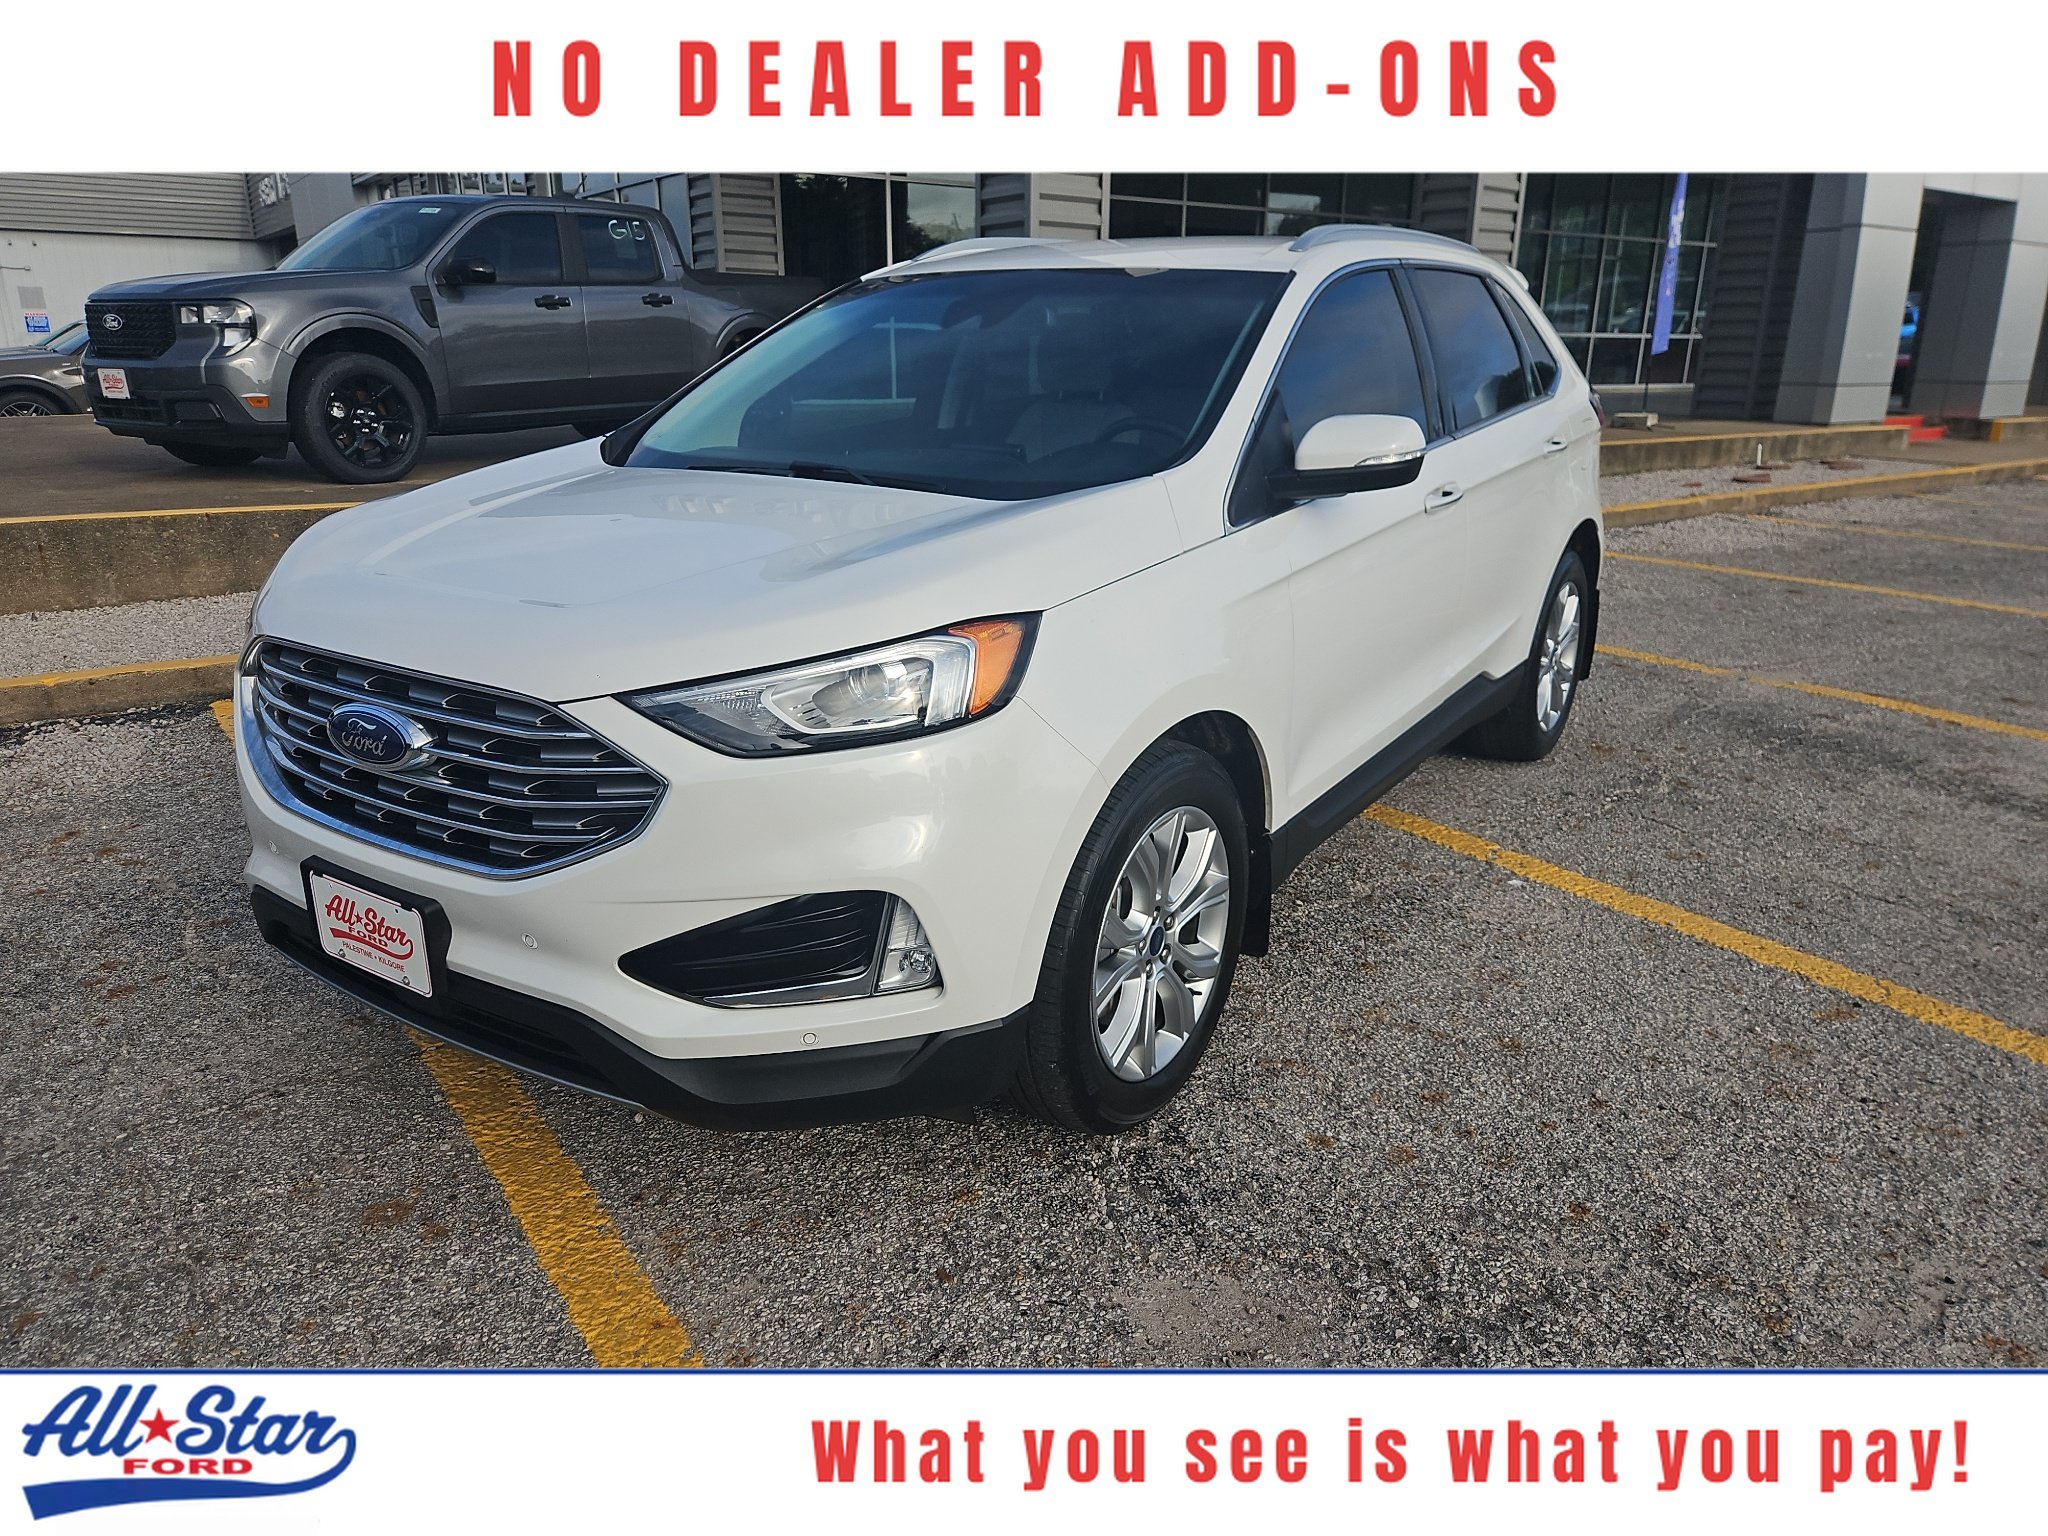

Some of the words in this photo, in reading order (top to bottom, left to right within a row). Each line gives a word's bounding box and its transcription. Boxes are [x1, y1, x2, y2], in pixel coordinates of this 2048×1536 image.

[341, 717, 387, 757] Ford
[325, 894, 356, 926] All
[363, 907, 410, 947] Star
[348, 926, 388, 948] FORD
[341, 940, 374, 960] PALESTINE
[378, 955, 406, 973] KILGORE
